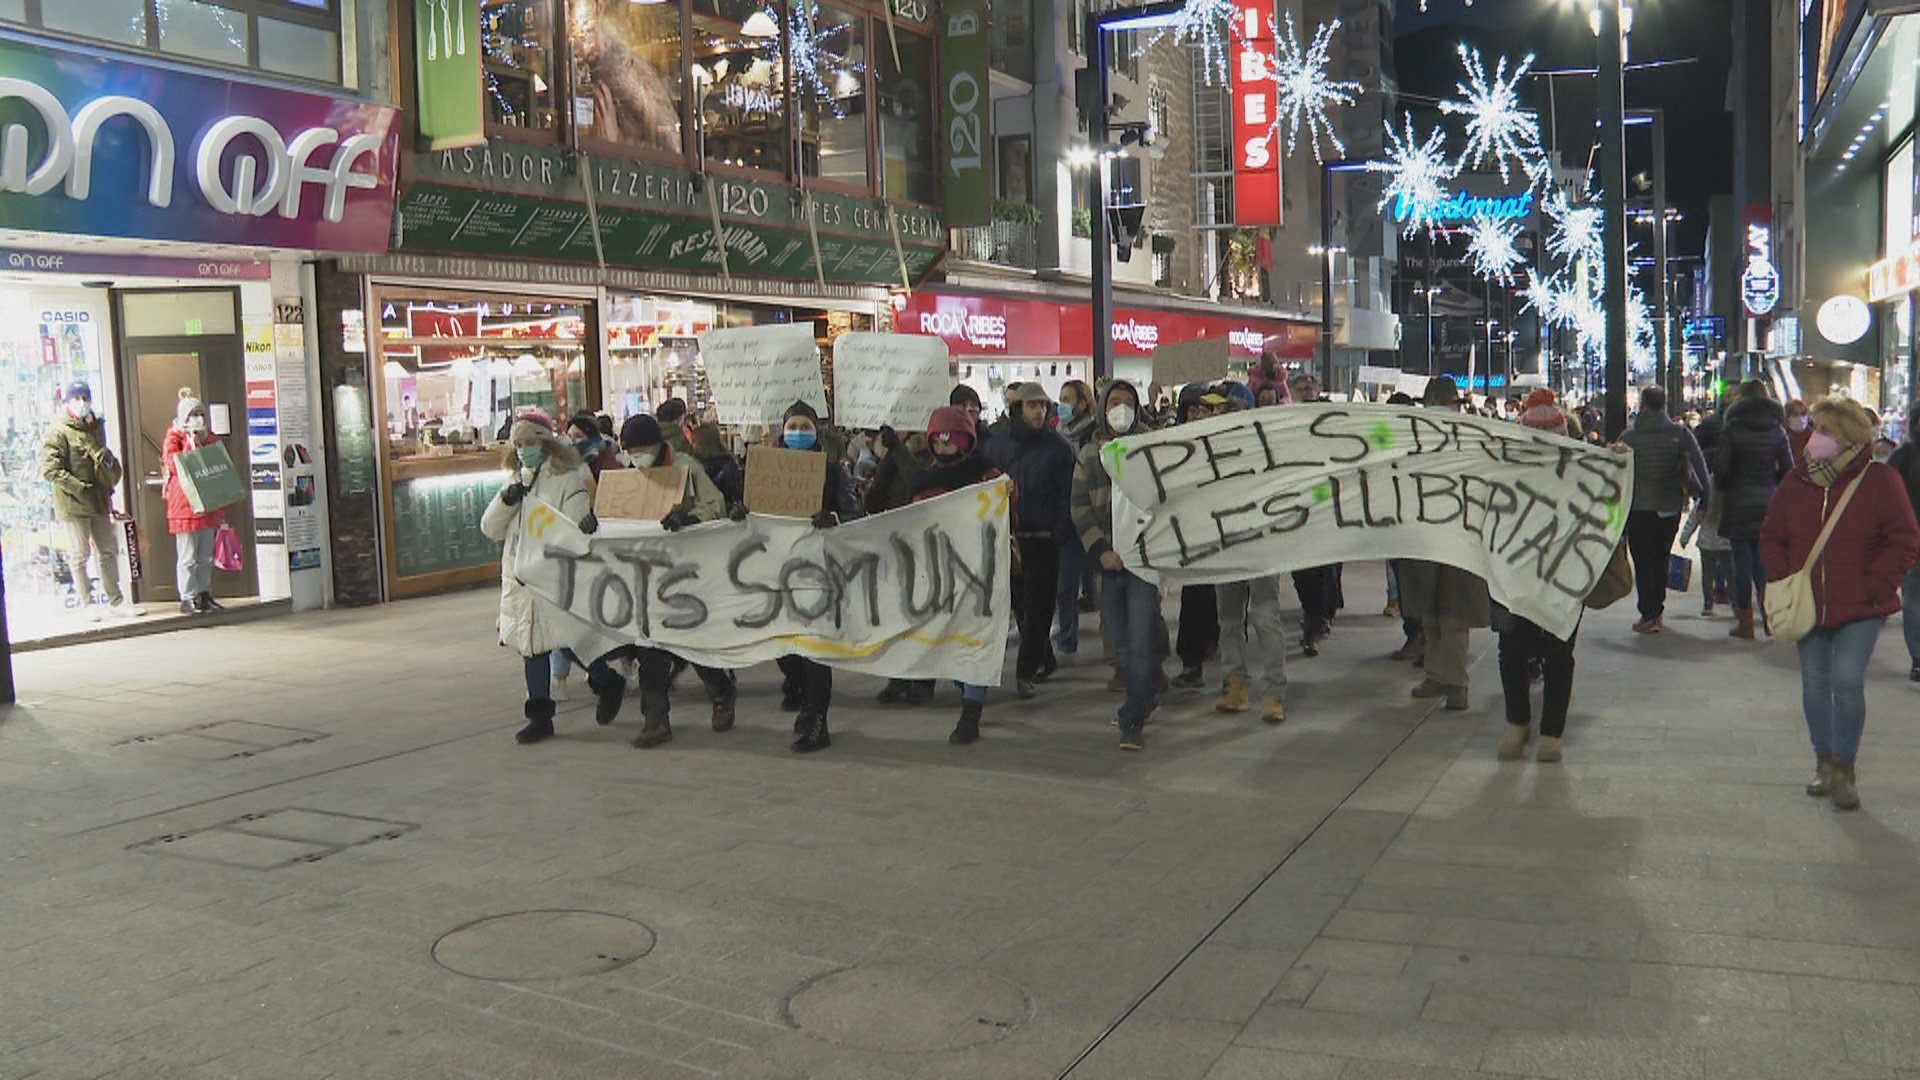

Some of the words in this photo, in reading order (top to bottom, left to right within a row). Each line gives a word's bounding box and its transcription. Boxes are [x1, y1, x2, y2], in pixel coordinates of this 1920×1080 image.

[950, 72, 981, 178] 120
[598, 168, 696, 206] IZZERIA
[720, 183, 769, 217] 120
[42, 311, 90, 323] CASIO
[245, 341, 272, 353] Nikon
[1126, 411, 1369, 504] PELS
[1171, 492, 1310, 567] LES
[727, 533, 881, 630] SOM
